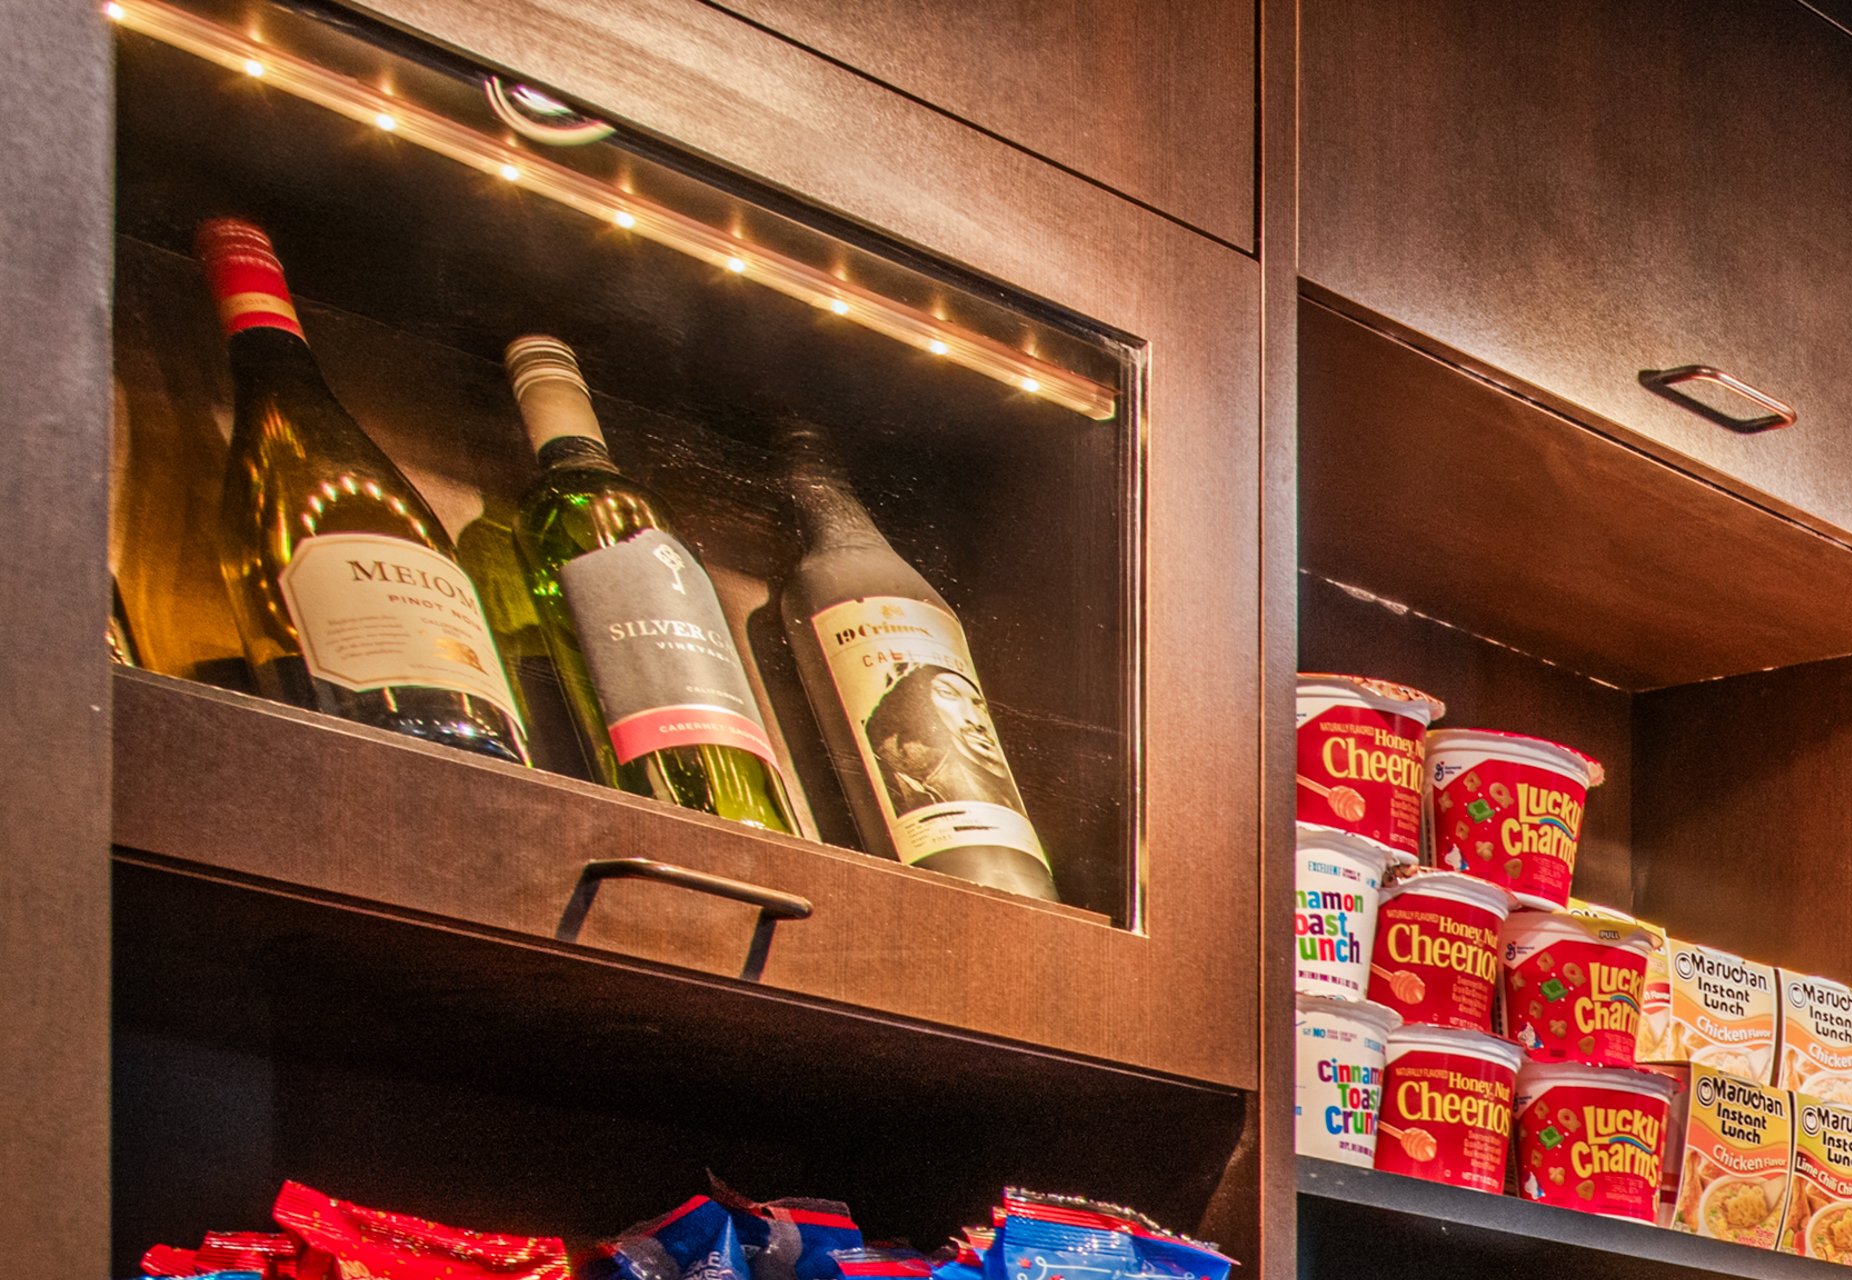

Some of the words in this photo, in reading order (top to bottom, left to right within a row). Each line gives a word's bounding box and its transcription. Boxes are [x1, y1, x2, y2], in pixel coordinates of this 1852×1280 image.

[609, 619, 705, 642] SILVER
[834, 627, 856, 646] 19
[858, 621, 934, 638] Crimes
[659, 722, 724, 734] CABERNET
[1374, 727, 1414, 757] Honey
[1600, 930, 1620, 940] PULL
[1387, 923, 1498, 985] Cheerios
[1691, 953, 1767, 992] Maruchan
[1697, 976, 1750, 1003] Instant
[1703, 993, 1745, 1017] Lunch
[1696, 1016, 1748, 1042] Chicken
[1815, 1021, 1852, 1044] Lunch
[1396, 1080, 1510, 1138] Cheerios
[1582, 1106, 1660, 1150] Lucky
[1571, 1140, 1660, 1189] Charms
